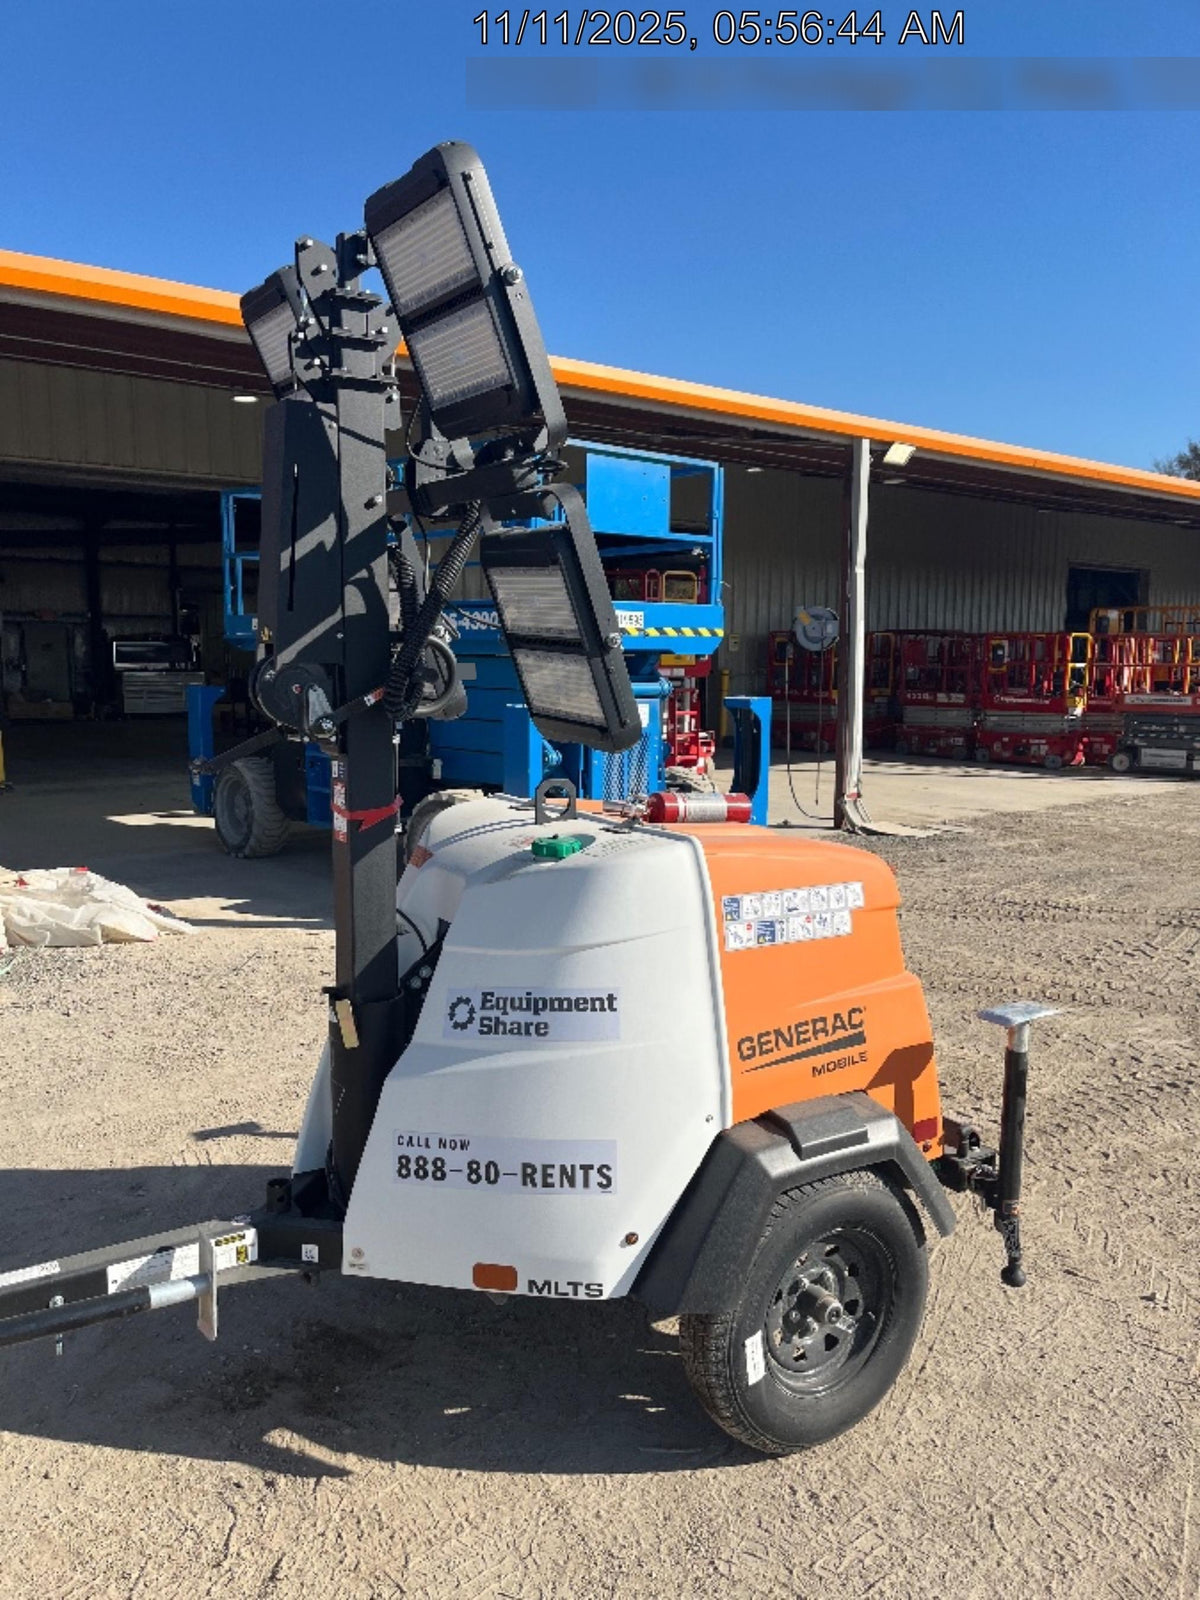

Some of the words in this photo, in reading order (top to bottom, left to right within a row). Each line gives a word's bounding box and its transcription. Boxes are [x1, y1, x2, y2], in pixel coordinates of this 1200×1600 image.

[480, 991, 618, 1015] Equipment
[477, 1016, 550, 1037] Share
[737, 1007, 865, 1062] GENERAC
[811, 1051, 869, 1078] MOBILE
[397, 1134, 431, 1149] CALL
[438, 1137, 470, 1152] NOW
[396, 1154, 613, 1191] 888-80-RENTS
[526, 1279, 604, 1299] MLTS
